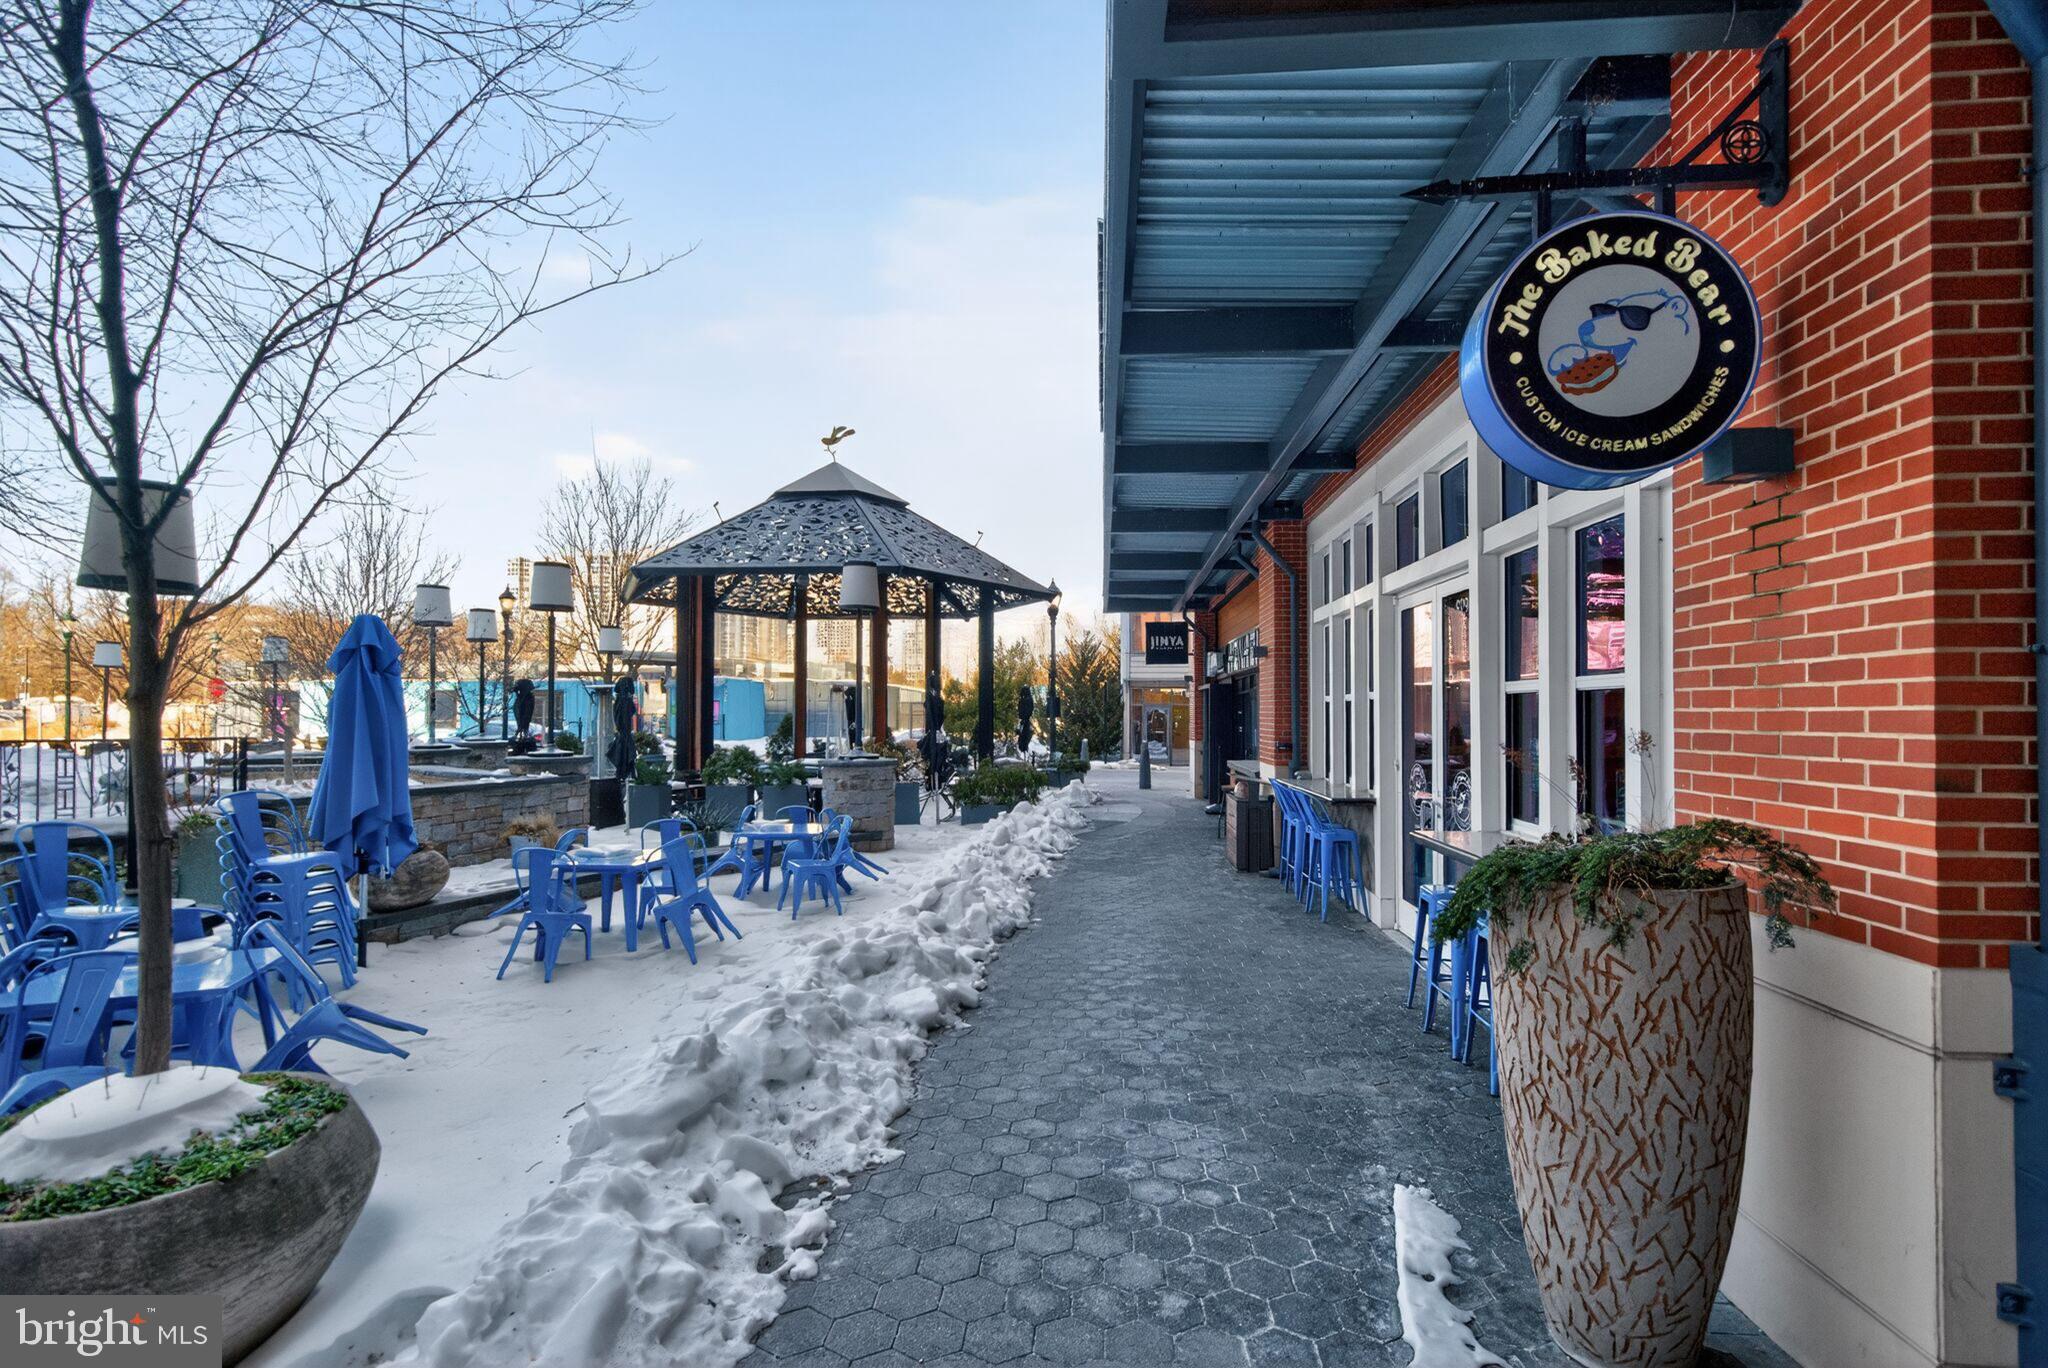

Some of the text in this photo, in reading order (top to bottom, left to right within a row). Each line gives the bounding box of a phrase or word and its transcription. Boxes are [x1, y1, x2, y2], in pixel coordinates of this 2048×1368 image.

[1498, 230, 1731, 337] The Baked Bear
[1516, 366, 1729, 452] CUSTOM ICE CREAM SANDWICHES
[1150, 635, 1184, 650] JINYA
